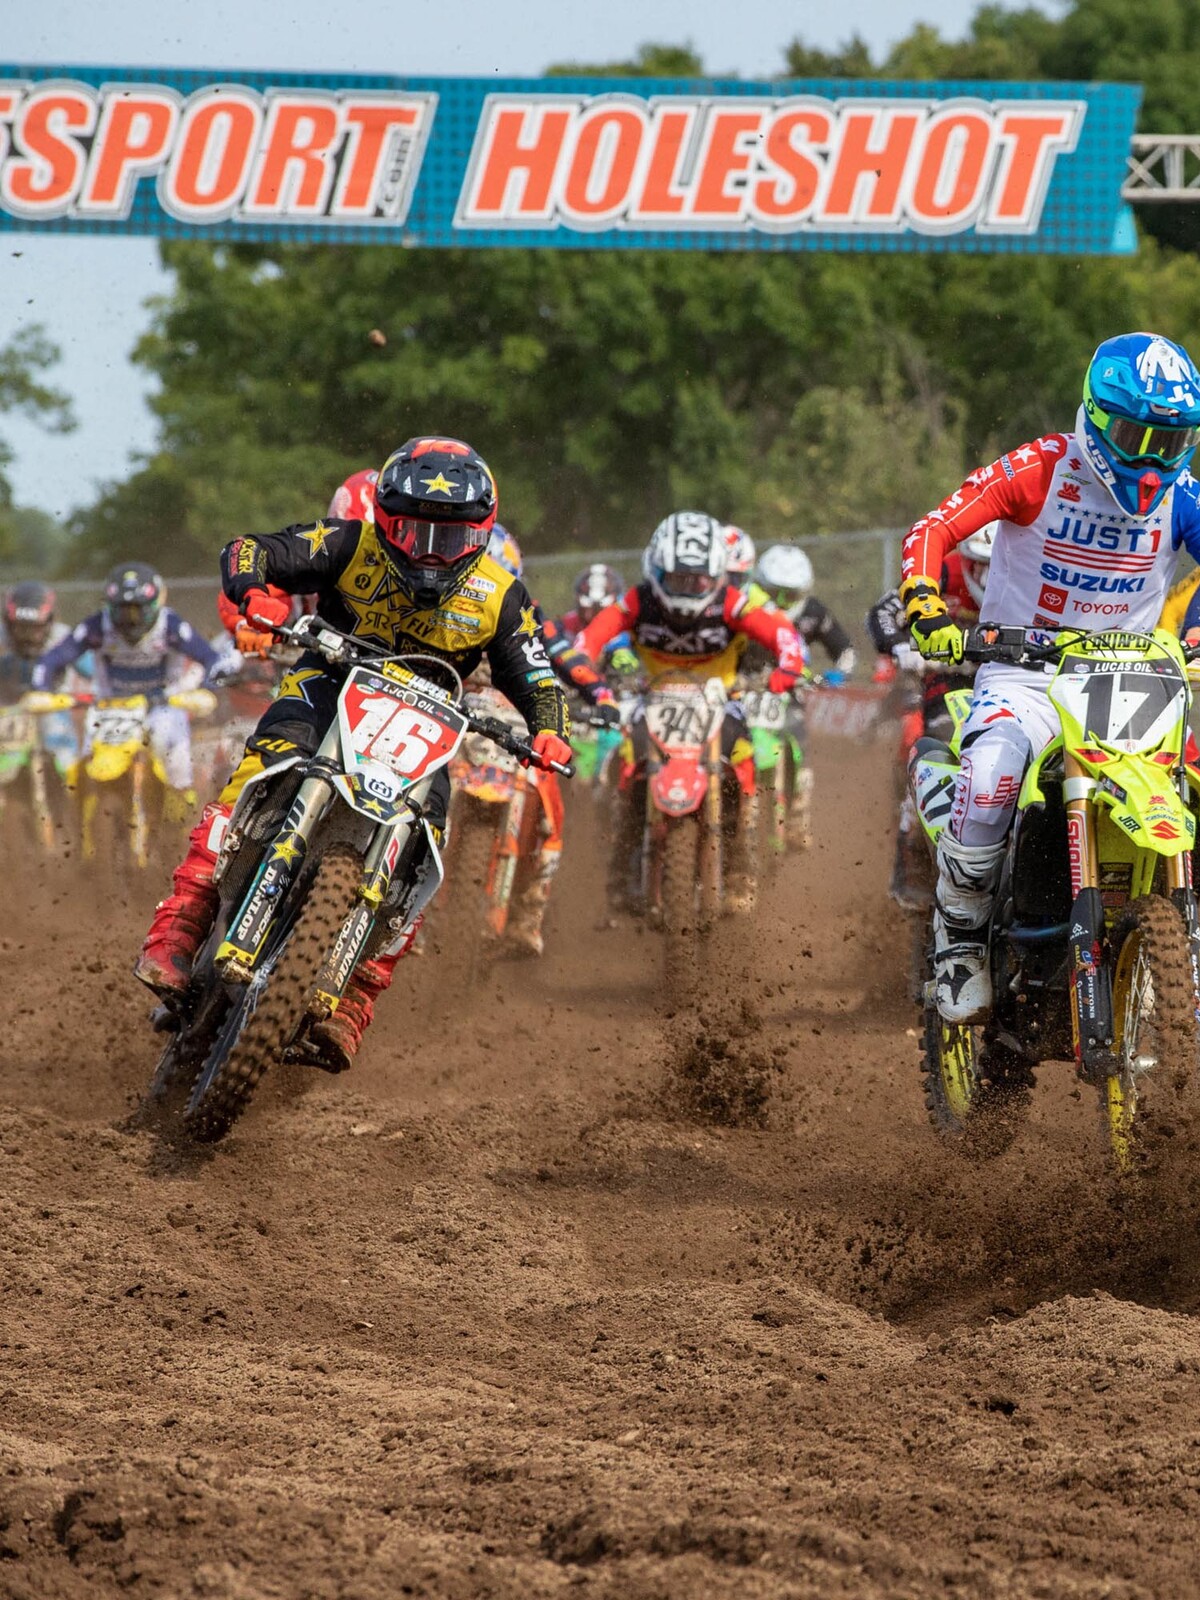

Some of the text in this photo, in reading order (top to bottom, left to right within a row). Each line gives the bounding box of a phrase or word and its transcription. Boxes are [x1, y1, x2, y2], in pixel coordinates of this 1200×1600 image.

[0, 80, 1087, 235] SPORT HOLESHOT
[1040, 562, 1146, 594] SUZUKI
[406, 618, 434, 638] FLY
[1073, 600, 1130, 615] TOYOTA
[1094, 662, 1152, 673] LUCAS OIL
[1081, 673, 1184, 742] 17
[351, 697, 443, 774] 16
[1118, 815, 1142, 834] JGR
[238, 866, 278, 940] DUNLOP
[334, 911, 370, 992] DUNLOP
[1088, 977, 1096, 1018] PISTONS
